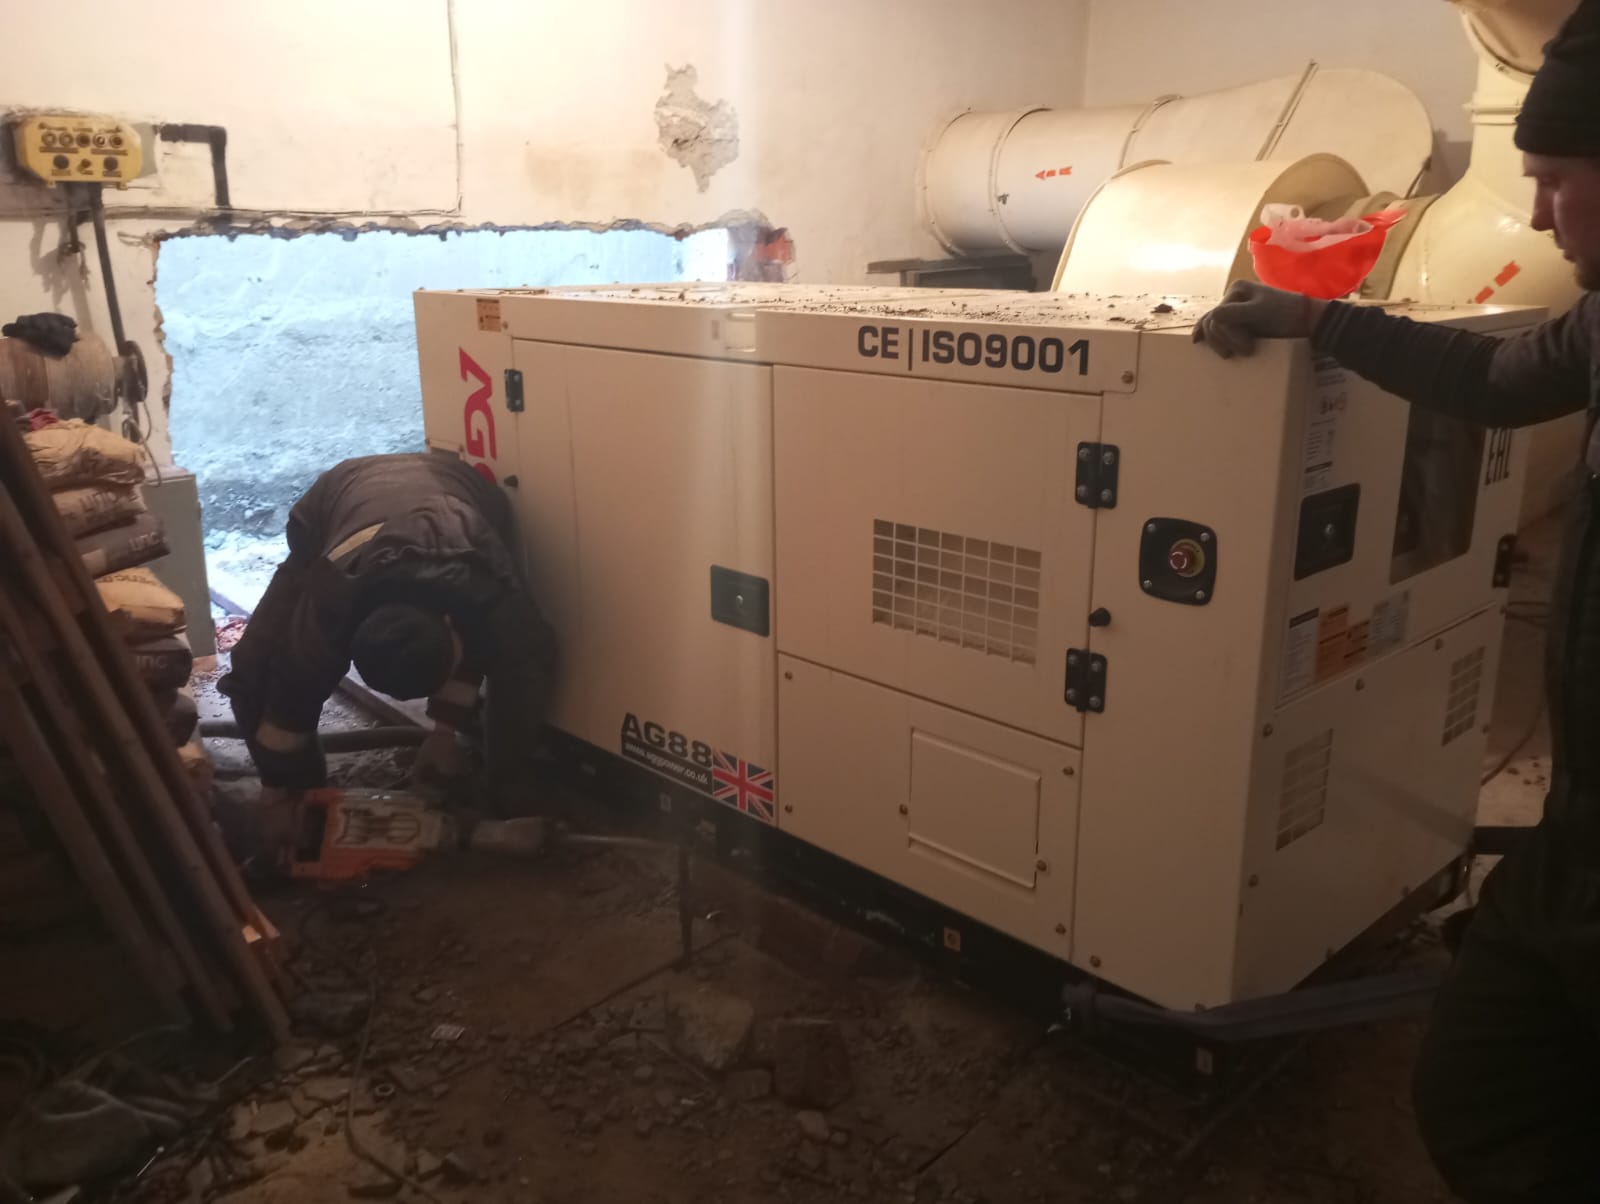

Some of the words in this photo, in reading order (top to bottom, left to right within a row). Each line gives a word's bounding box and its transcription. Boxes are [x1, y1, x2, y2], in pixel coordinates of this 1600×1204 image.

[858, 325, 899, 359] CE
[922, 329, 1090, 376] ISO9001
[621, 712, 712, 769] AG88
